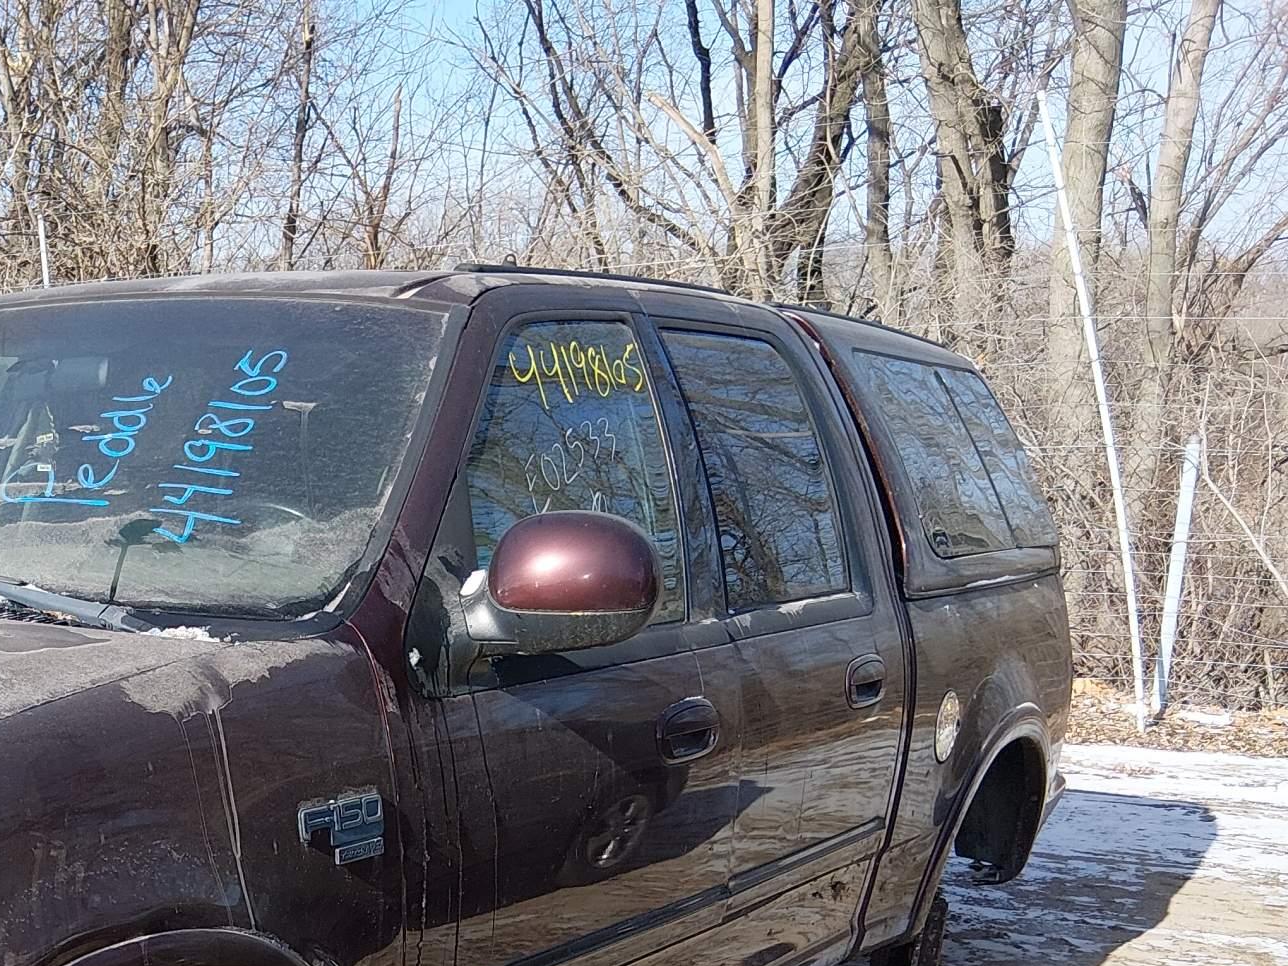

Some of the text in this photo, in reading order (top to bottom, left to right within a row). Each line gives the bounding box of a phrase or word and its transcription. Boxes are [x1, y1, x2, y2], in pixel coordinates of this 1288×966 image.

[509, 341, 643, 410] 44198105
[2, 376, 173, 506] Peddle
[152, 350, 288, 543] 44198105
